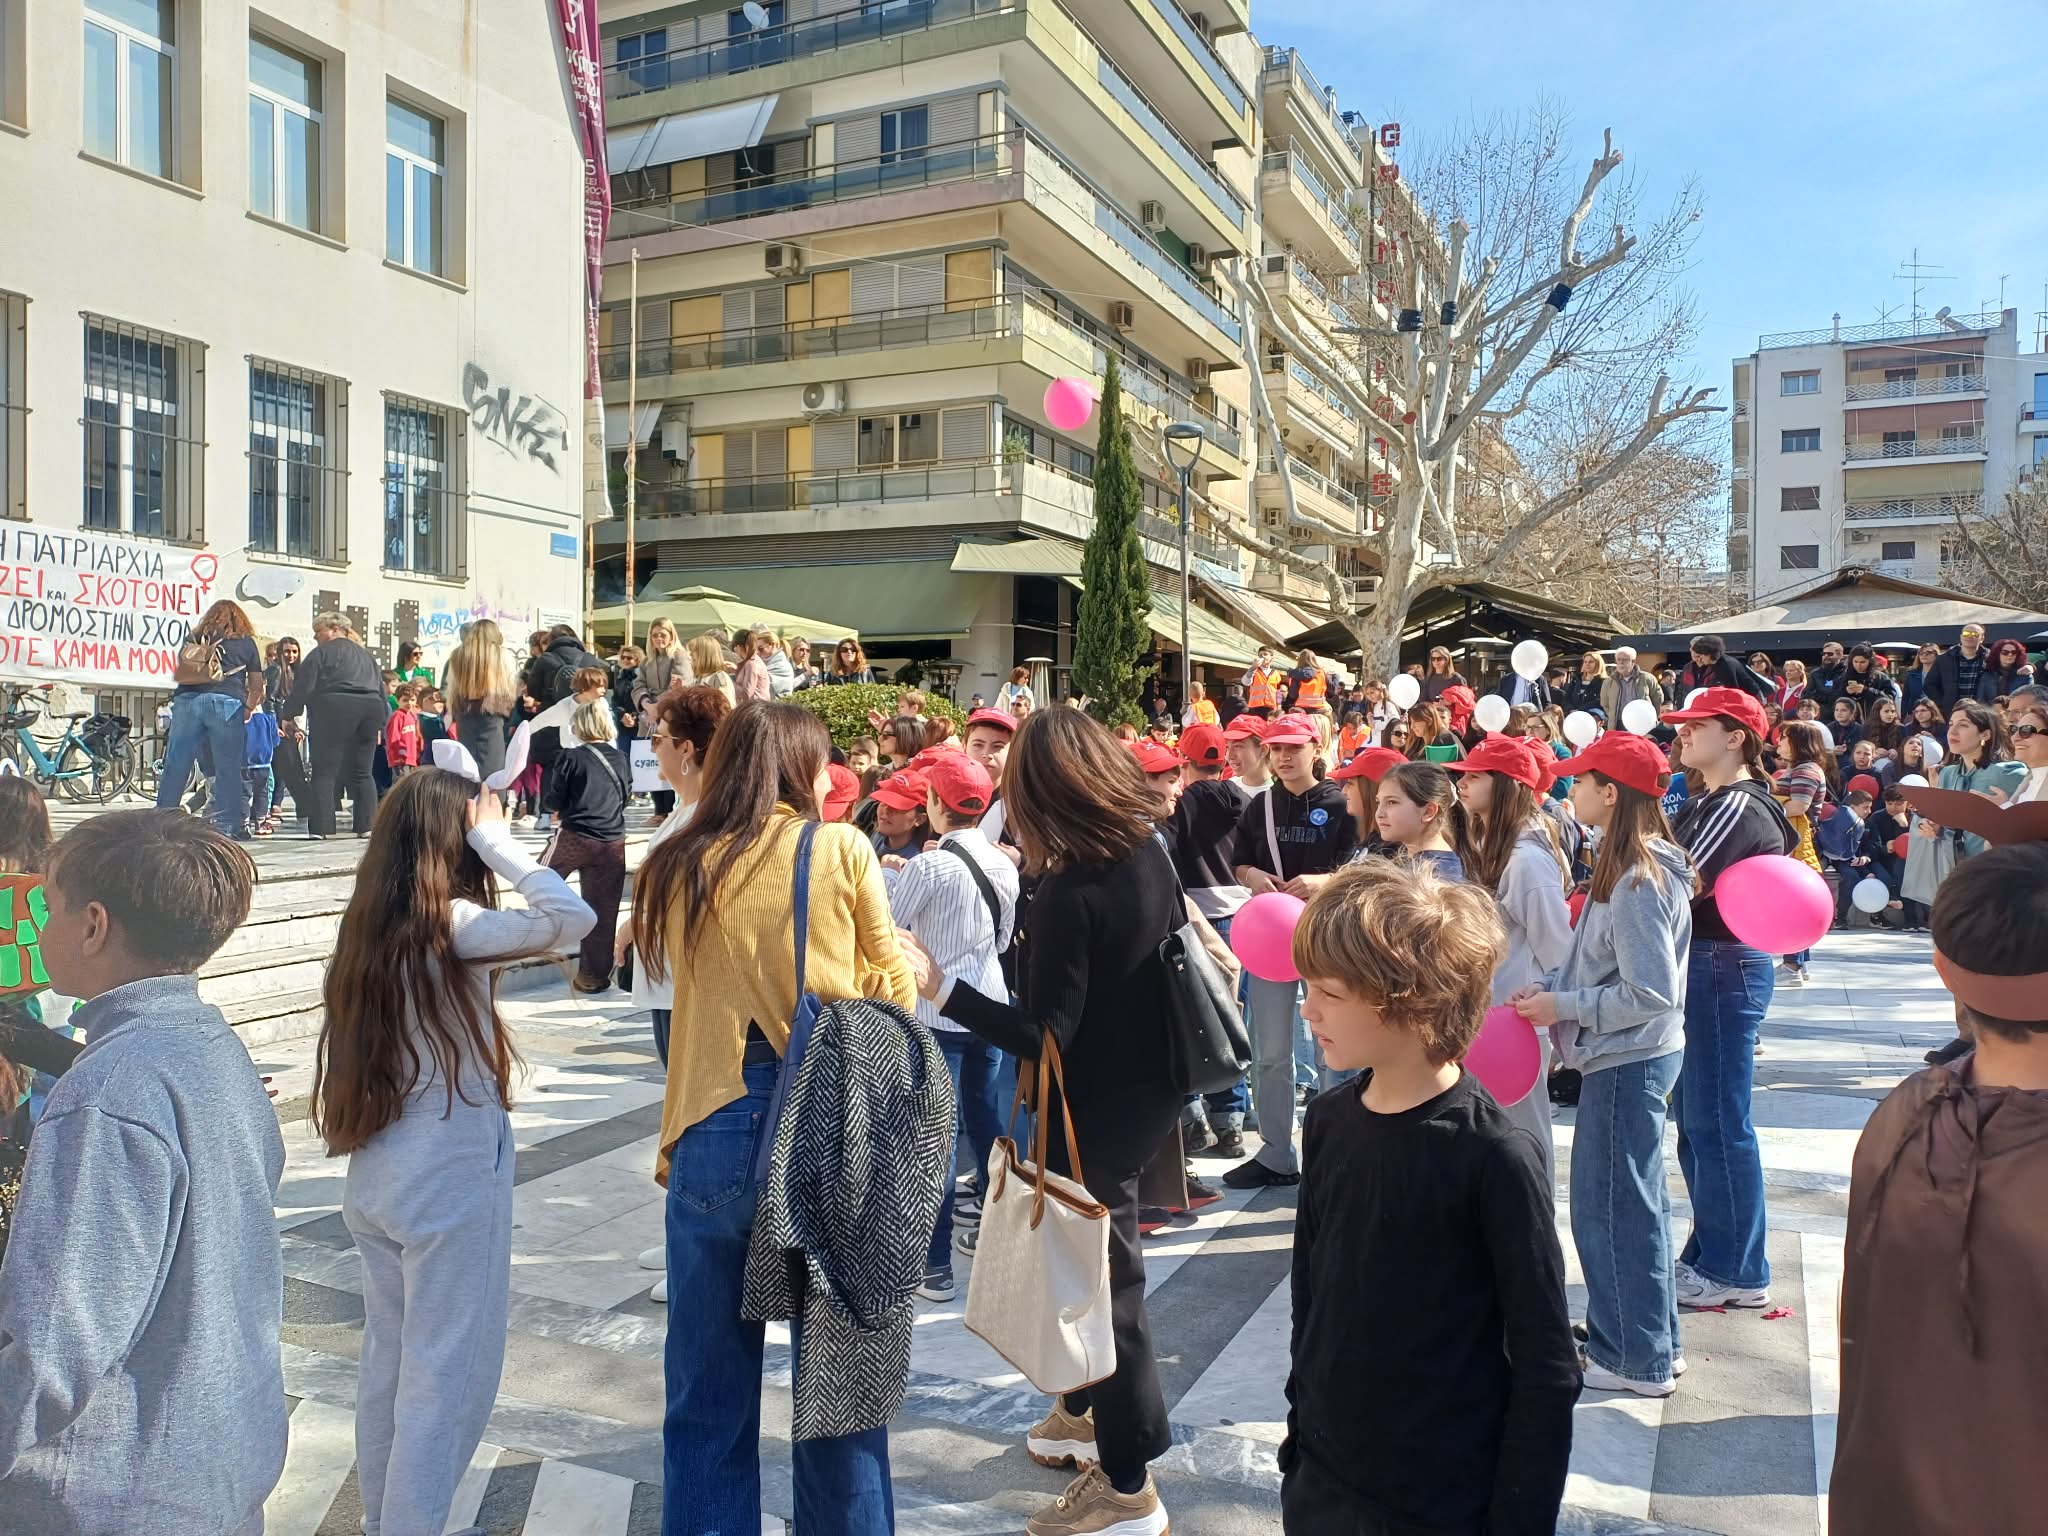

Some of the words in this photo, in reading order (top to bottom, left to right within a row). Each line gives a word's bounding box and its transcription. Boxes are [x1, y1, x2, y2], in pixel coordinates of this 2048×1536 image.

[17, 530, 163, 580] ΠΑΤΡΙΑΡΧΙΑ
[47, 589, 67, 601] ΚΑΙ
[54, 638, 120, 670] ΚΑΜΙΑ
